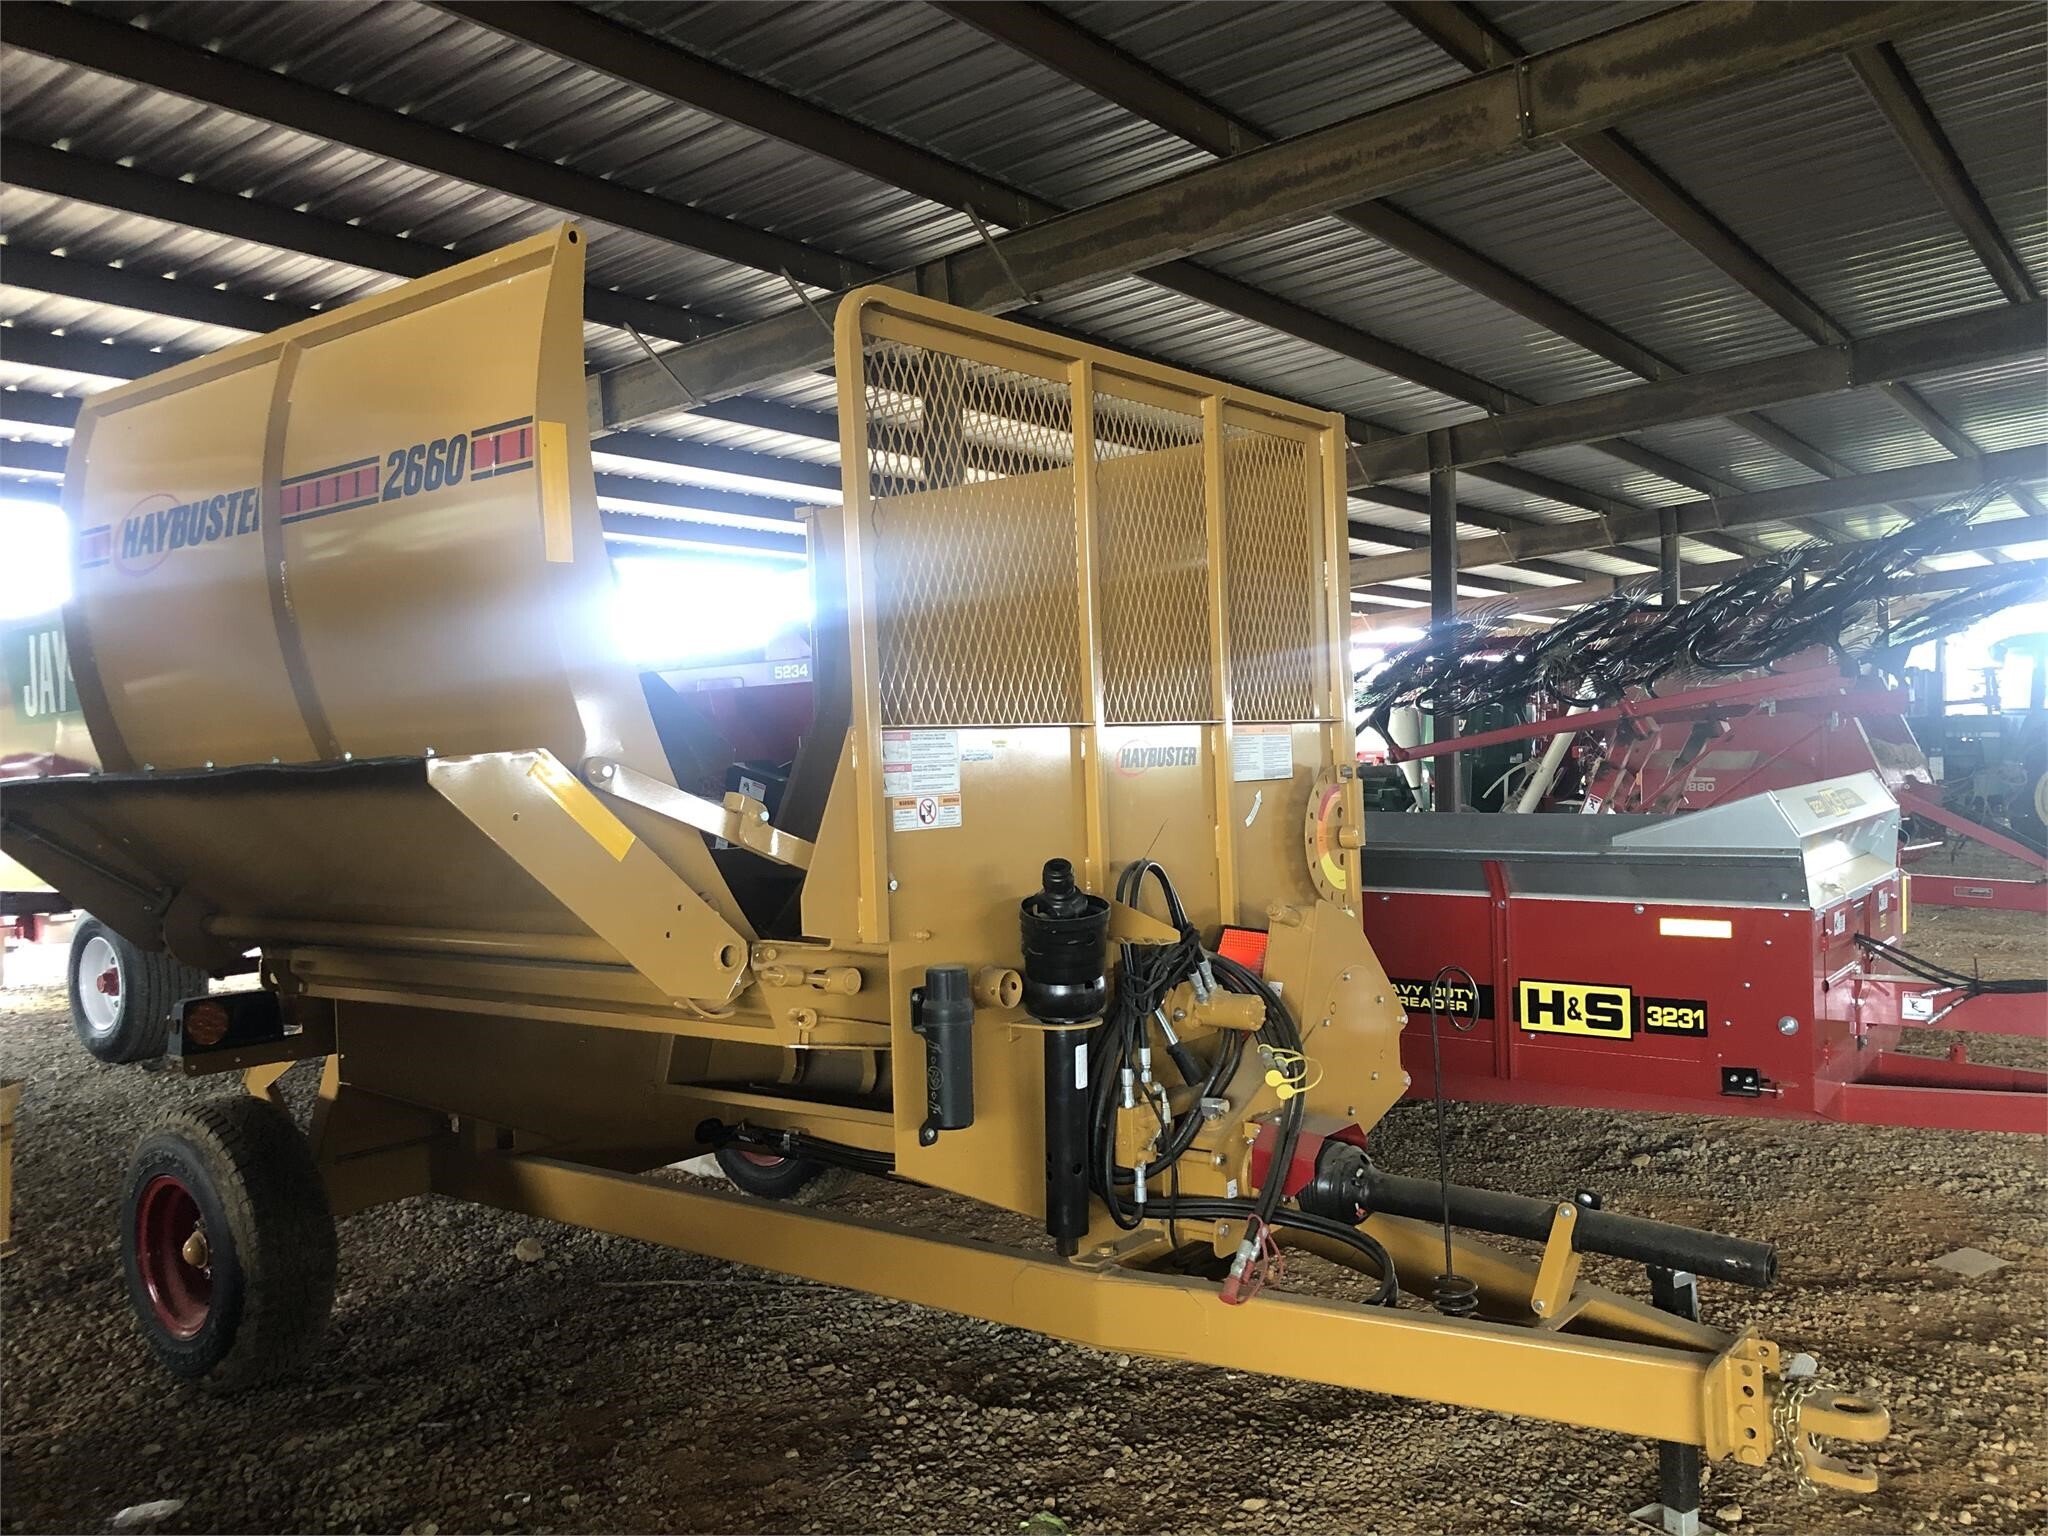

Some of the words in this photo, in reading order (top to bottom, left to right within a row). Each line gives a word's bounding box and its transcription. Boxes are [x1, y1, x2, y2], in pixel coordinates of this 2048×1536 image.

[382, 434, 467, 502] 2660
[24, 630, 73, 717] JAY
[774, 663, 808, 679] 5234
[1120, 746, 1197, 769] HAYBUSTER
[1391, 983, 1423, 996] AVY
[1430, 986, 1475, 1000] DUTY
[1398, 996, 1468, 1012] READER
[1527, 988, 1623, 1031] H&S
[1647, 1006, 1704, 1029] 3231
